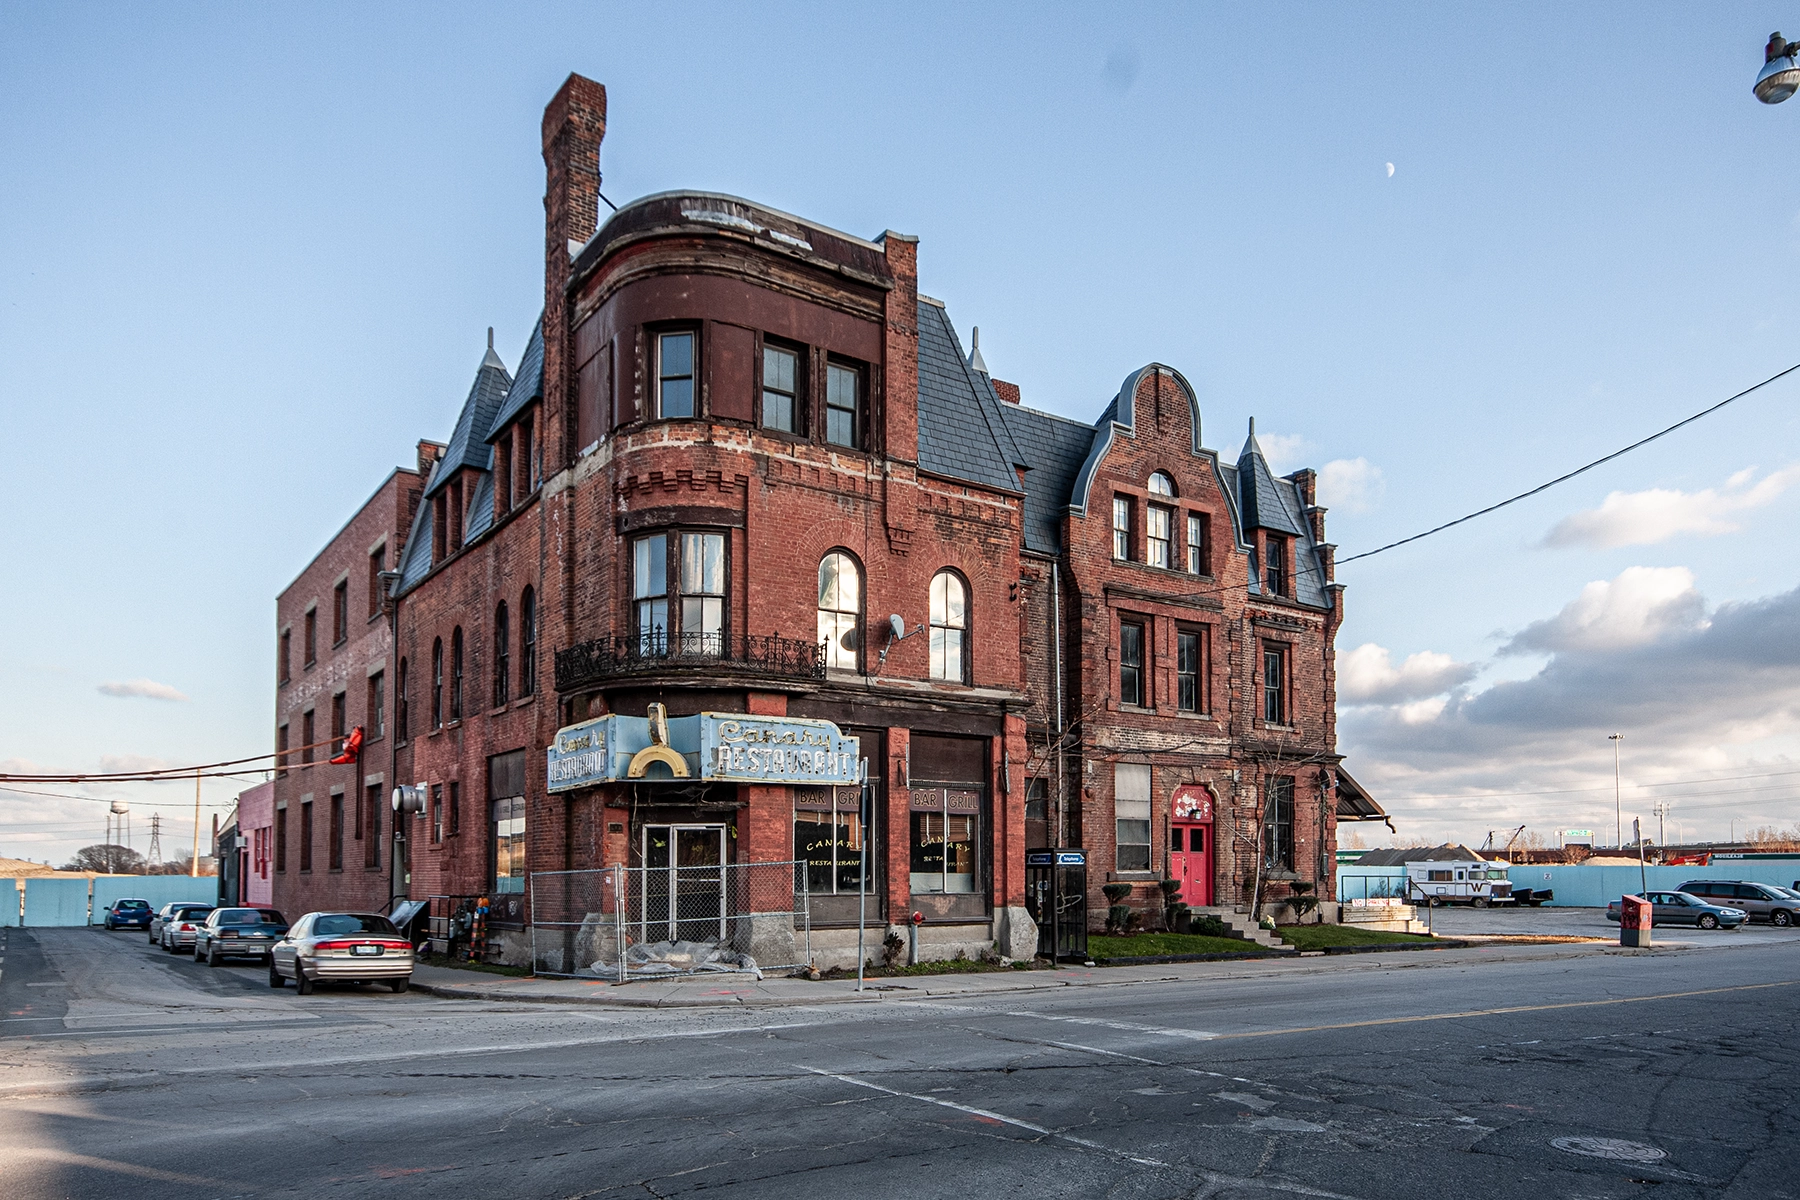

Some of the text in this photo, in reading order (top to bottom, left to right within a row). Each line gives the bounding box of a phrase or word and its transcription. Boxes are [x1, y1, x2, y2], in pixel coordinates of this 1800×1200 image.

[559, 729, 605, 754] Canary
[719, 720, 830, 752] Canary
[549, 749, 606, 782] RESTAURANT
[717, 745, 850, 776] RESTAURANT
[800, 790, 860, 807] BAR GRI
[914, 792, 978, 810] BAR GRILL
[920, 836, 971, 853] CANARY
